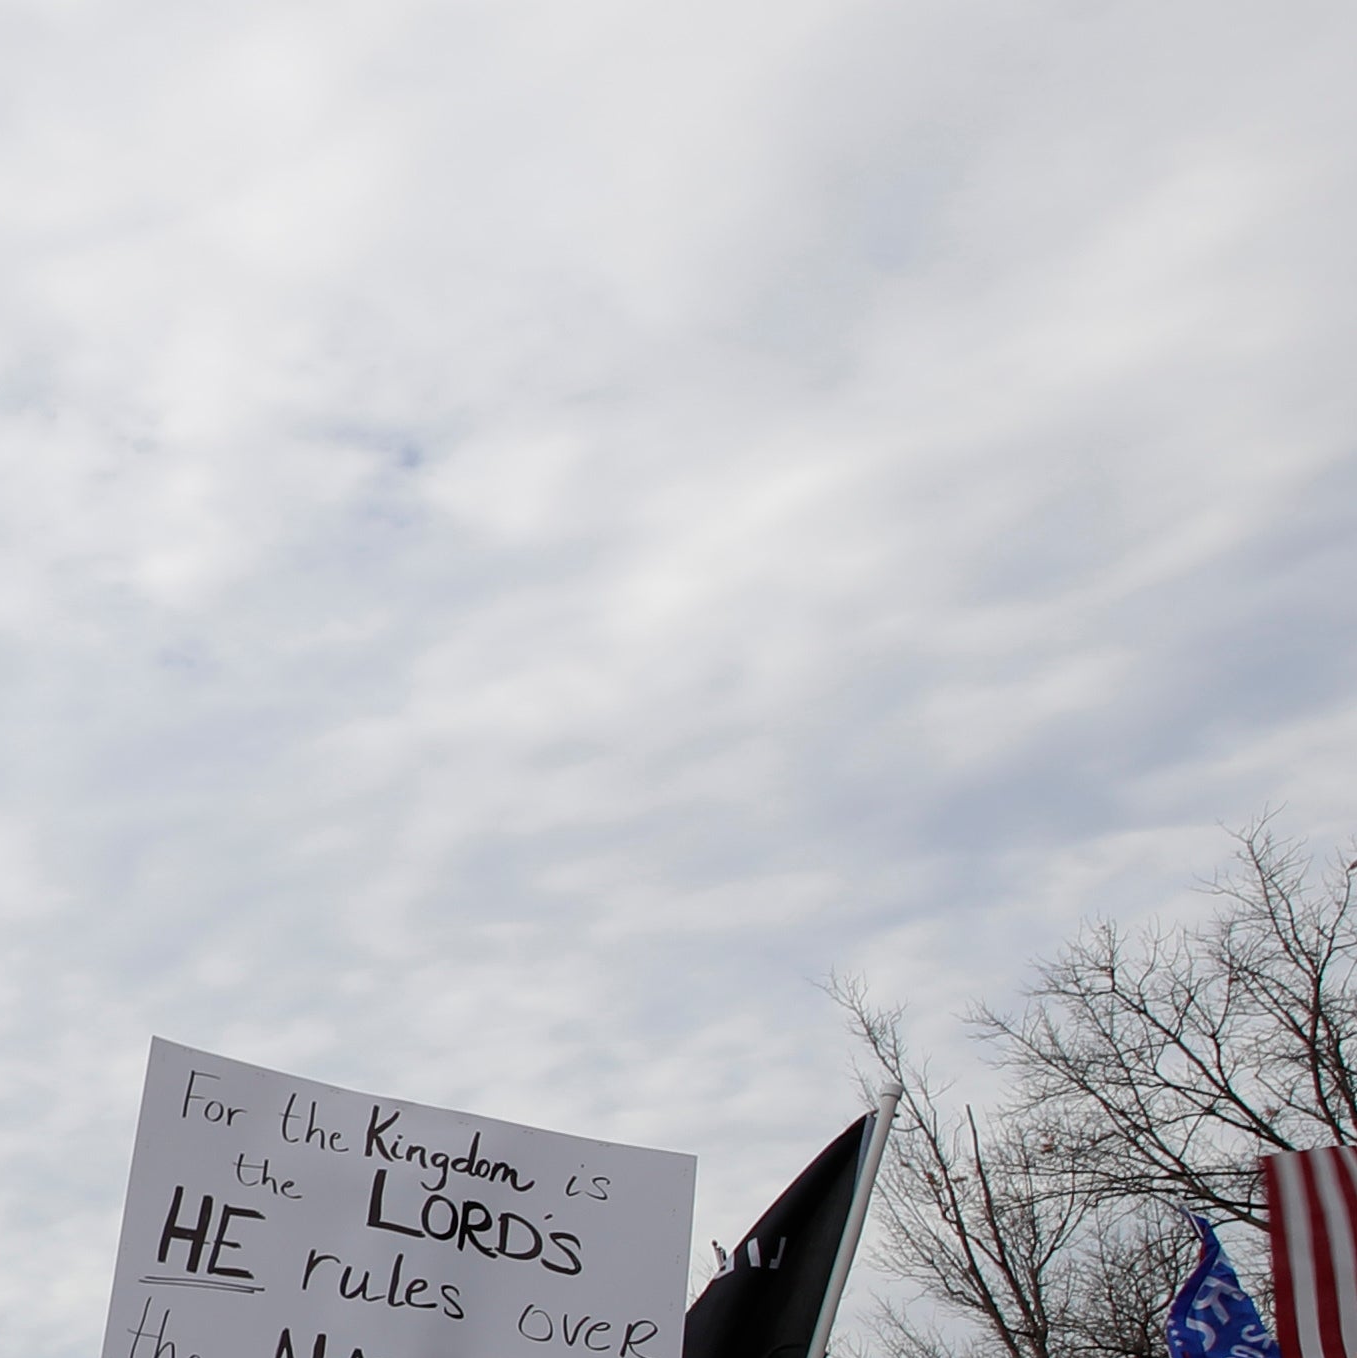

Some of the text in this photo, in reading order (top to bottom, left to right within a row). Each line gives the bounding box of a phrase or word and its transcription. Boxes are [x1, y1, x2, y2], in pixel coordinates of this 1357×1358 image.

[181, 1070, 611, 1201] For the Kingdom is
[233, 1153, 303, 1199] the
[157, 1185, 266, 1280] HE
[302, 1249, 465, 1321] rules
